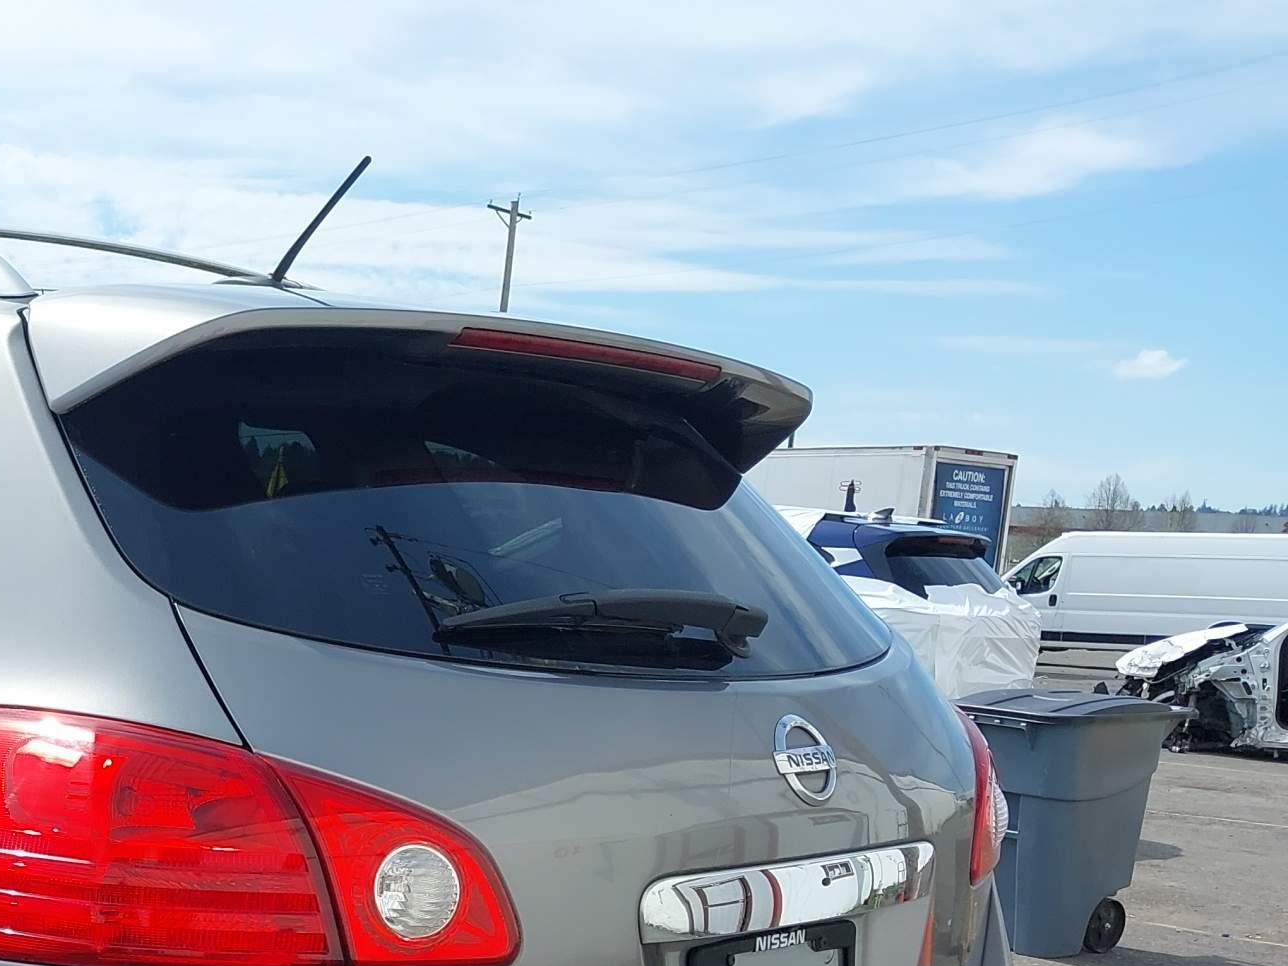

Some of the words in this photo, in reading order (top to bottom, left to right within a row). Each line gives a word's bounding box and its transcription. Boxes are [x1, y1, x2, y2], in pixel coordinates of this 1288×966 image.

[953, 470, 985, 483] CAUTION:
[786, 750, 835, 769] NISSAN
[755, 929, 806, 952] NISSAN
